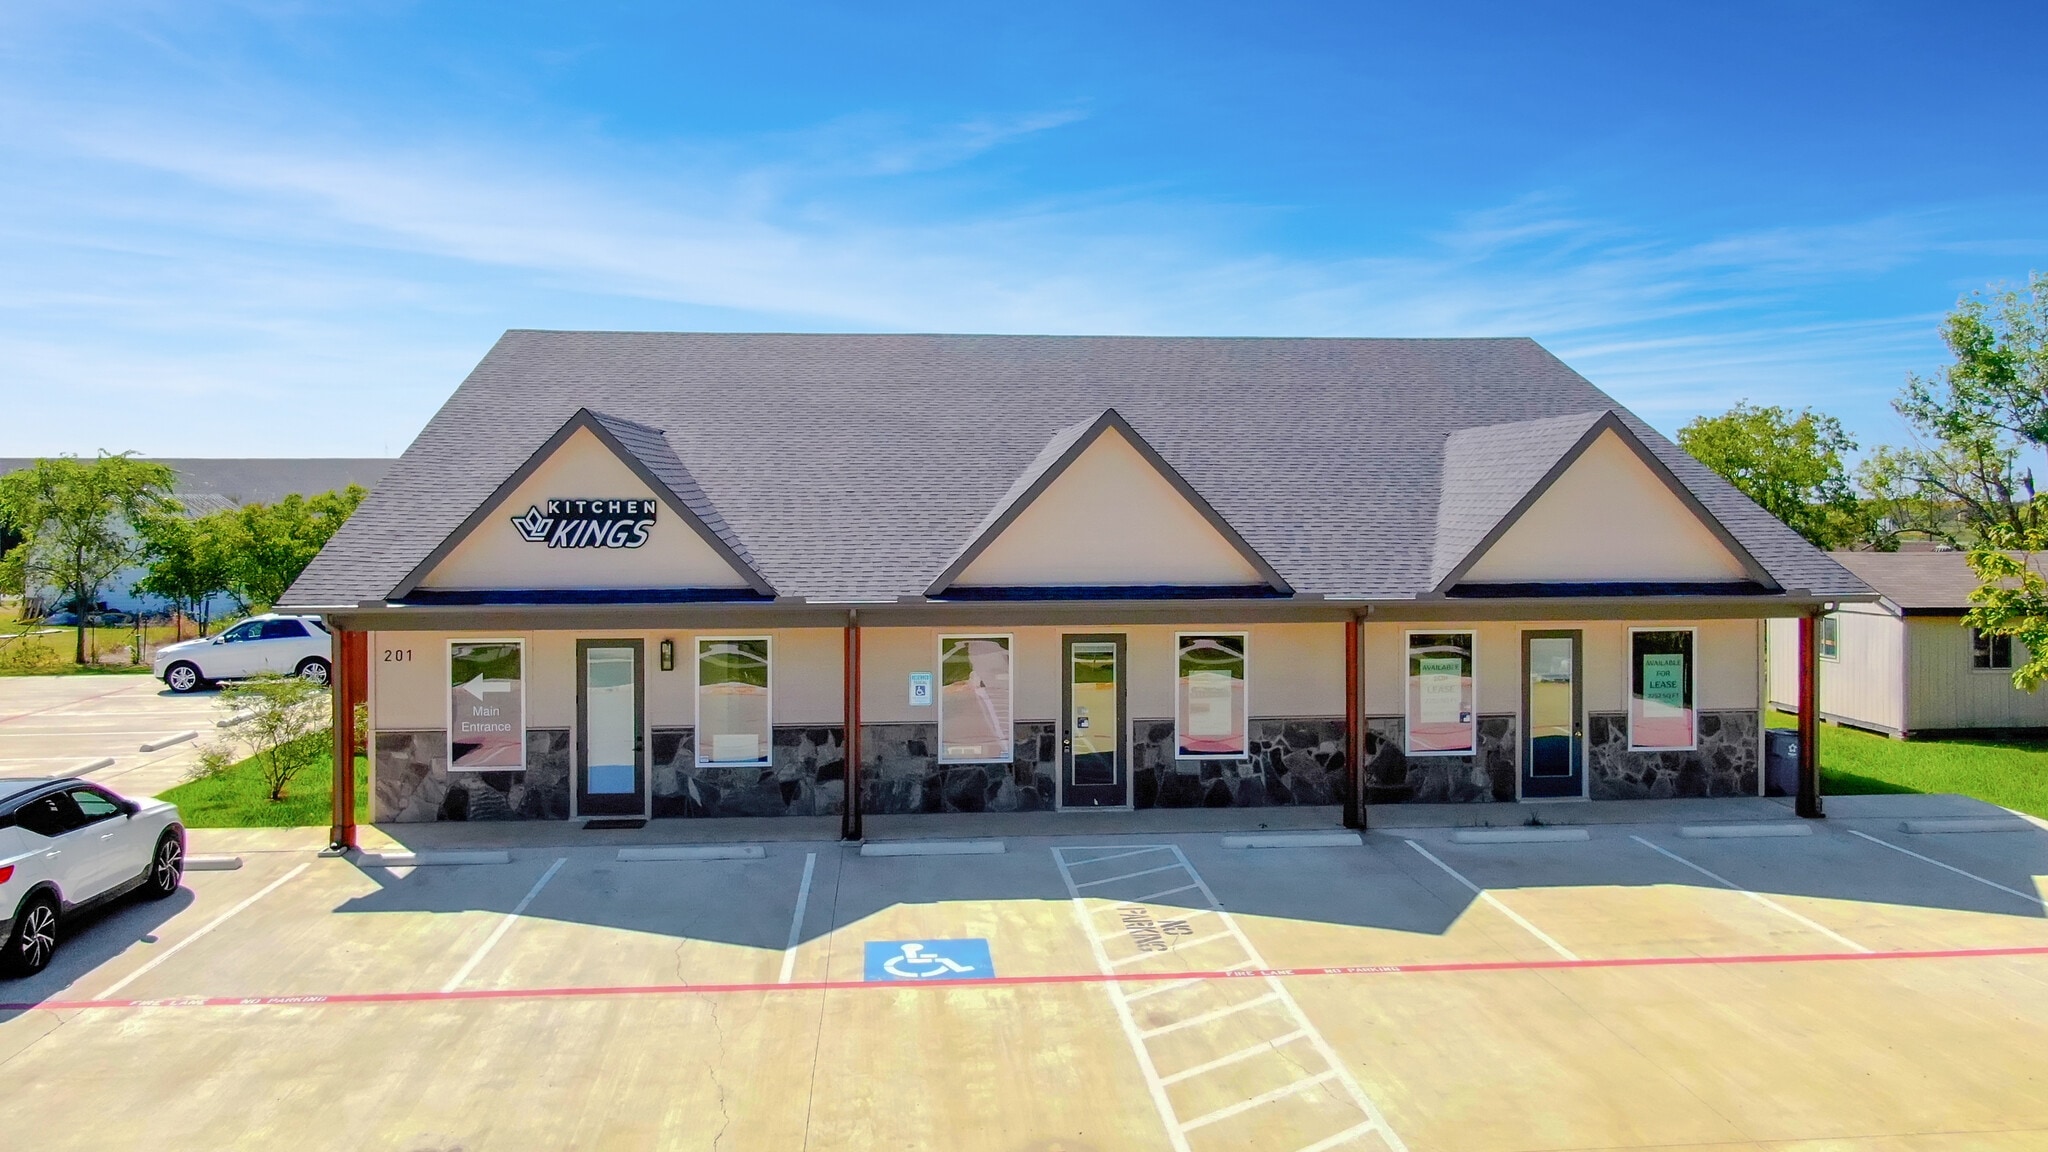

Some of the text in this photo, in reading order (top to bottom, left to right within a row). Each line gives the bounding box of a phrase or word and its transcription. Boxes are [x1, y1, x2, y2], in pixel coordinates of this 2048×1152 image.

[548, 500, 656, 514] KITCHEN
[548, 519, 656, 547] KINGS
[384, 649, 412, 662] 201
[1422, 663, 1460, 671] AVAILABLE
[1427, 685, 1457, 694] LEASE
[1649, 680, 1677, 689] LEASE
[472, 705, 500, 717] Main
[461, 721, 511, 732] Entrance
[1117, 907, 1168, 952] PARKING
[1157, 920, 1194, 936] NO
[1226, 966, 1401, 978] FIRE LANE NO PARKING
[266, 996, 328, 1004] PARKING
